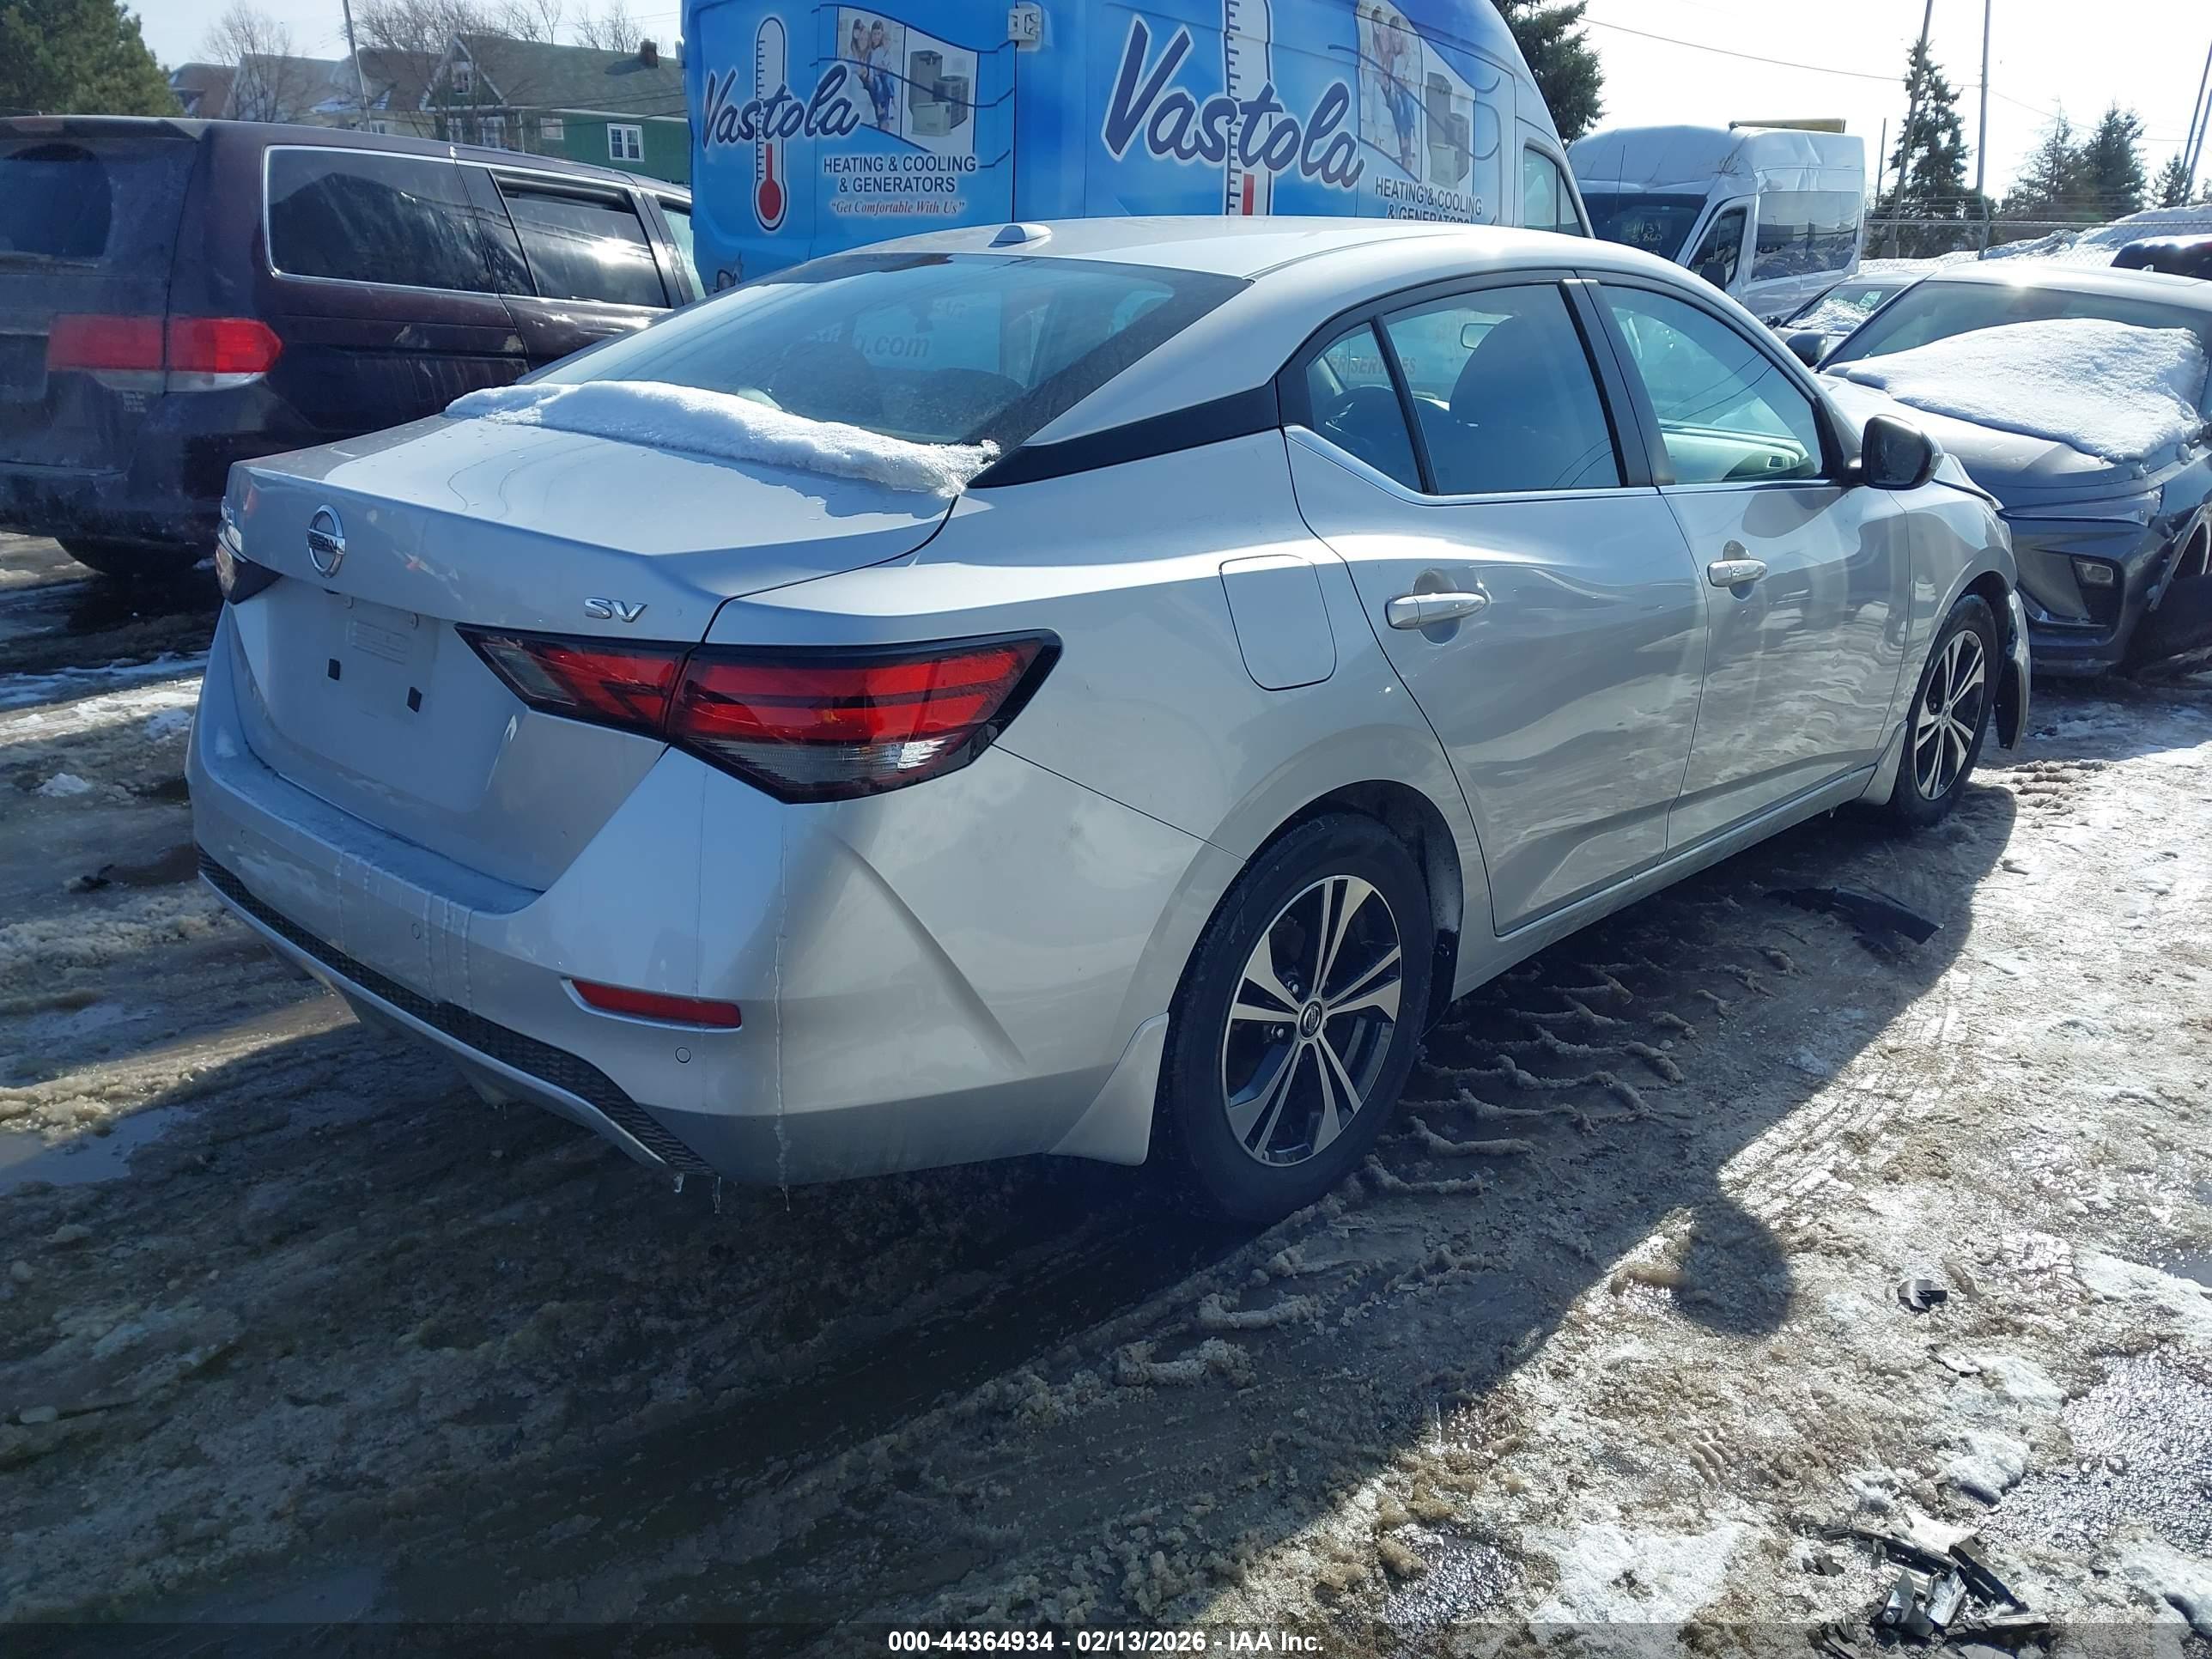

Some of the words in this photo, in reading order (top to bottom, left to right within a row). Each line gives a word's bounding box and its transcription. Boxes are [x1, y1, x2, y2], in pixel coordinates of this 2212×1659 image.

[702, 64, 860, 149] Vastola
[1104, 20, 1365, 188] Vastola
[823, 157, 884, 173] HEATING
[888, 156, 898, 172] &
[902, 155, 976, 172] COOLING
[839, 178, 848, 193] &
[853, 177, 956, 192] GENERATORS
[1375, 176, 1425, 204] HEATING
[1426, 187, 1437, 206] &
[1437, 190, 1482, 216] COOLING
[854, 201, 913, 216] Comfortable
[916, 201, 939, 213] With
[584, 597, 648, 623] SV
